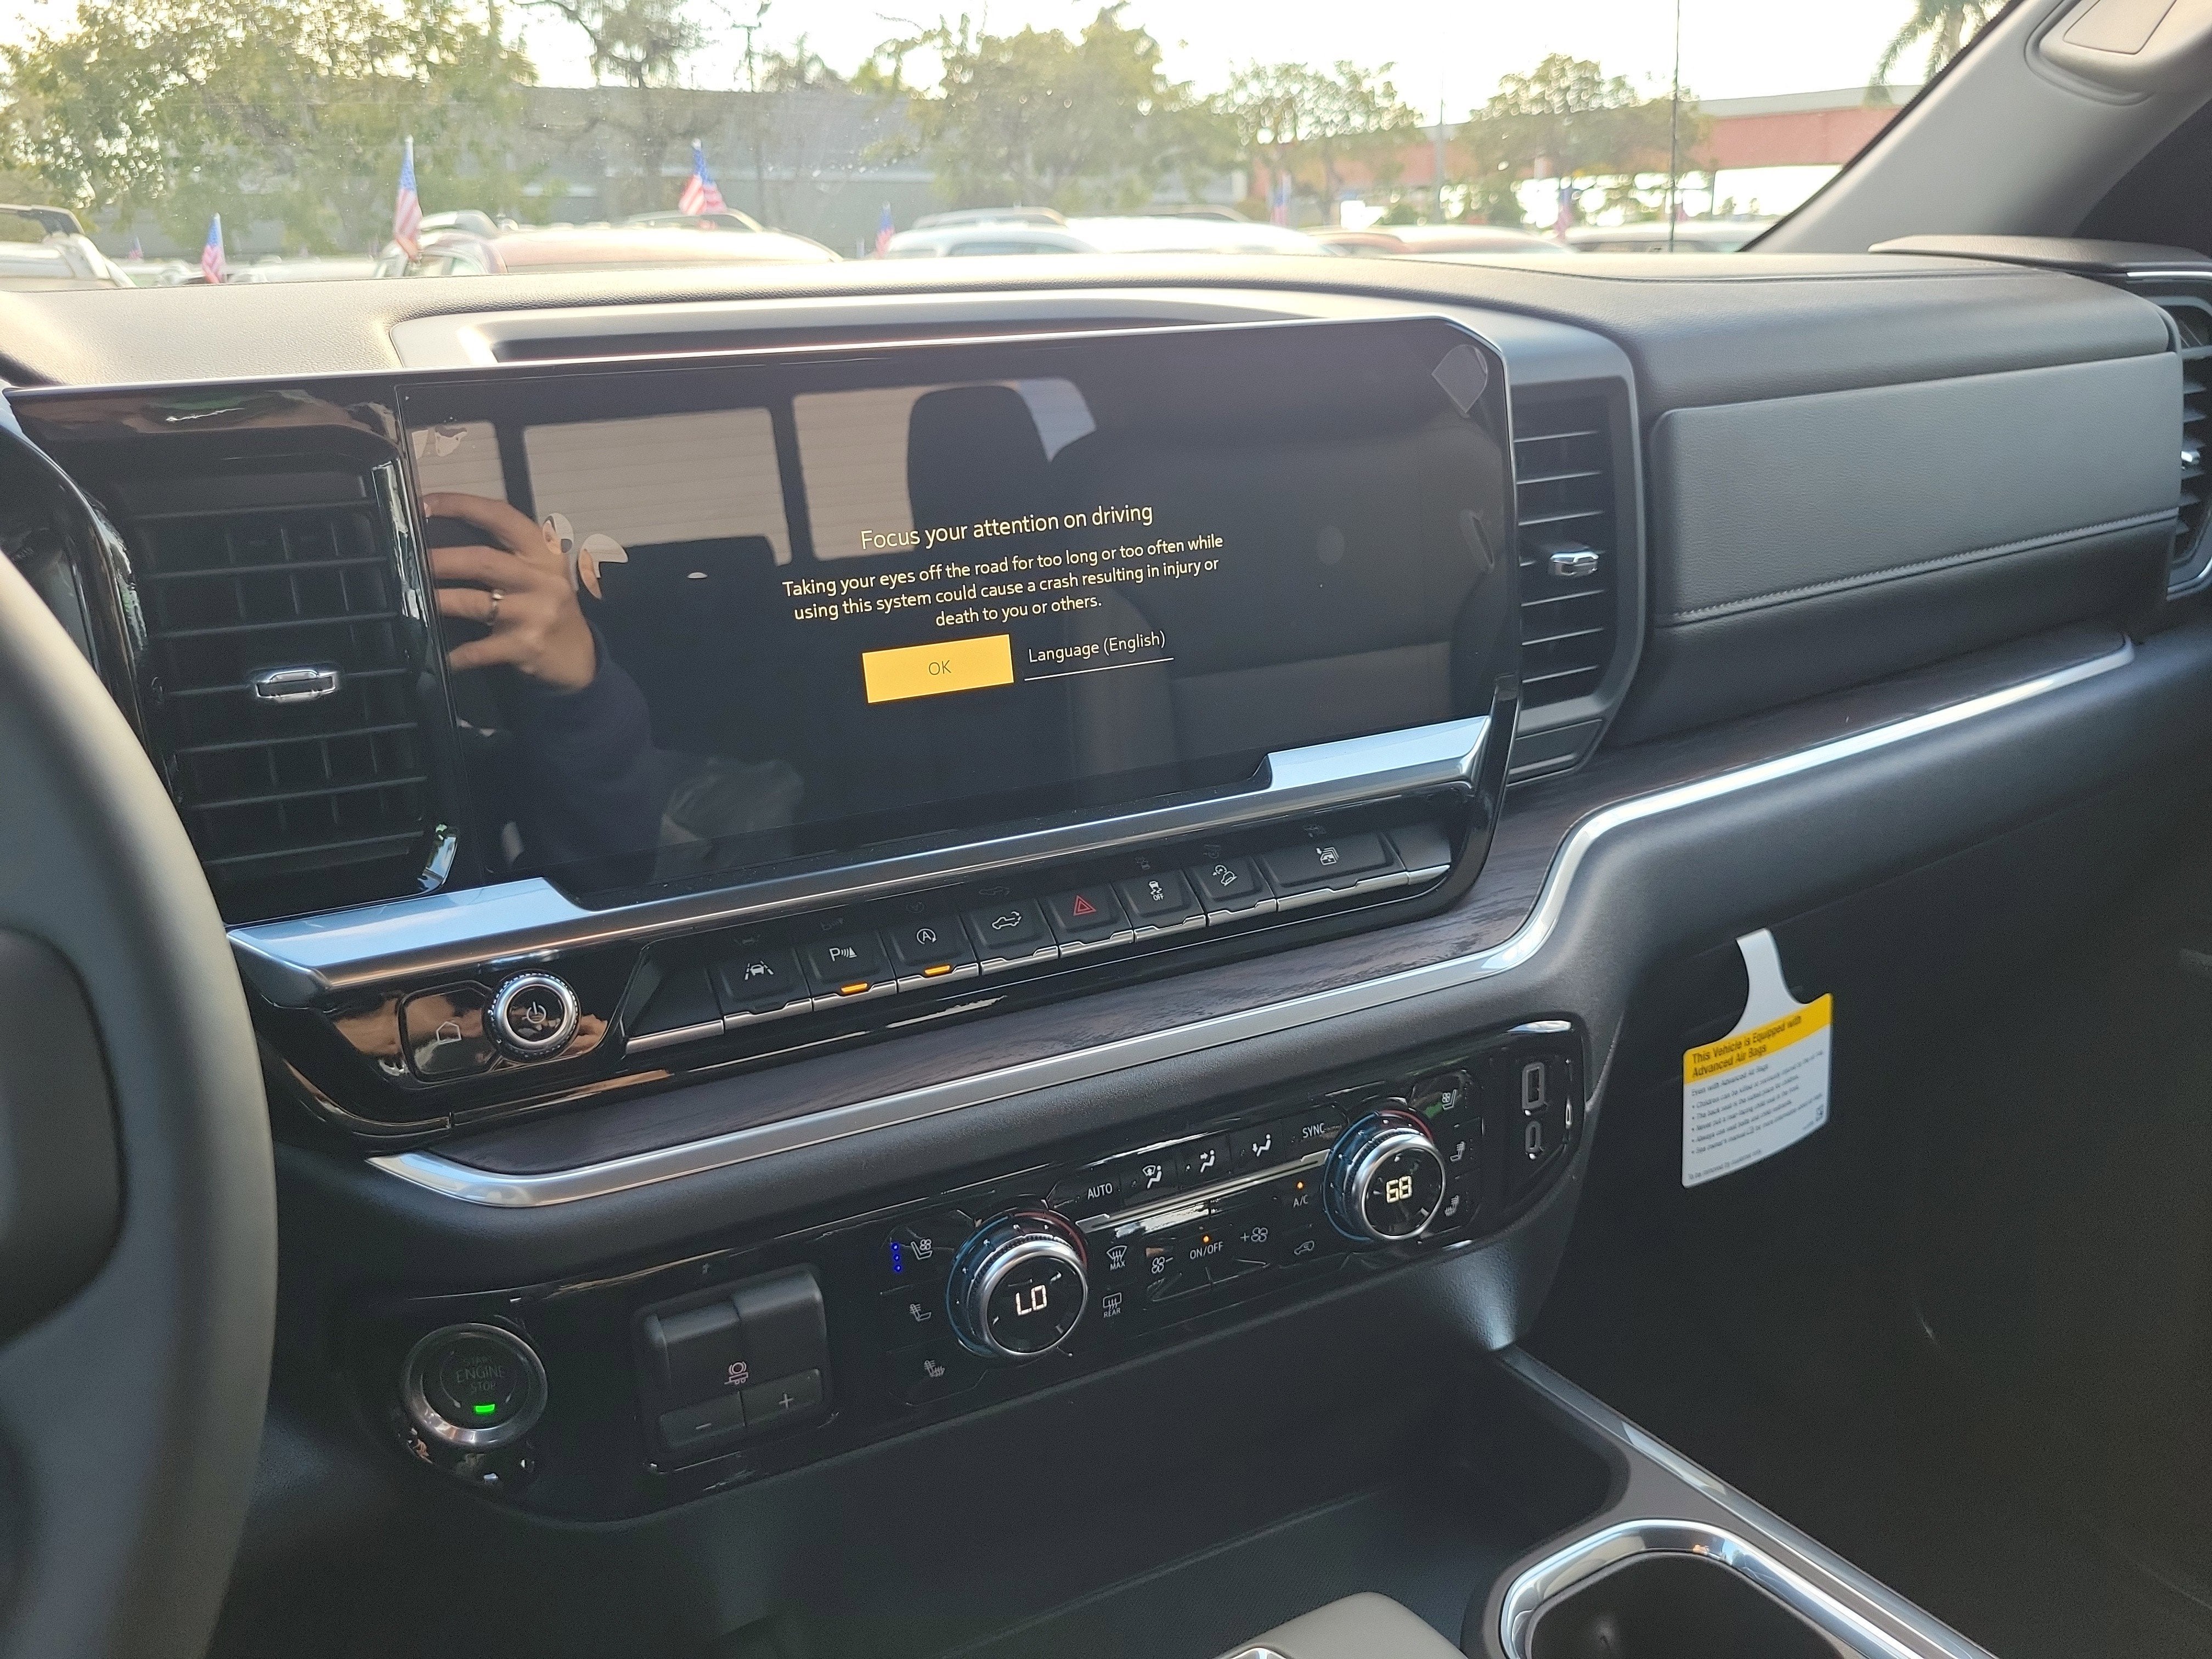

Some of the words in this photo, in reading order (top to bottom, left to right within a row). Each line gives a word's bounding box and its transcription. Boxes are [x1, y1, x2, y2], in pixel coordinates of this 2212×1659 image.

[861, 530, 921, 550] Focus
[924, 526, 968, 549] your
[973, 514, 1059, 538] attention
[1064, 514, 1087, 528] on
[1092, 504, 1153, 526] driving
[782, 579, 837, 597] Taking
[839, 576, 876, 595] your
[879, 572, 916, 590] eyes
[919, 563, 943, 581] off
[945, 562, 970, 578] the
[974, 556, 1008, 575] road
[1012, 555, 1034, 571] for
[1036, 554, 1062, 568] too
[1065, 549, 1098, 566] long
[1101, 549, 1117, 560] or
[1119, 545, 1144, 558] too
[1147, 539, 1184, 555] often
[1187, 533, 1223, 551] while
[794, 603, 839, 620] using
[842, 597, 872, 614] this
[876, 594, 932, 614] system
[935, 583, 977, 603] could
[980, 583, 1024, 597] cause
[1027, 582, 1036, 592] a
[1039, 572, 1079, 590] crash
[1082, 567, 1143, 586] resulting
[1147, 564, 1160, 578] in
[1163, 561, 1201, 579] injury
[1204, 560, 1219, 571] or
[936, 607, 979, 626] death
[982, 607, 998, 620] to
[1001, 605, 1028, 623] you
[1032, 602, 1048, 614] or
[1051, 595, 1102, 612] others.
[1029, 644, 1099, 663] Language
[1104, 630, 1165, 656] (English)
[928, 659, 952, 675] OK
[1692, 1052, 1711, 1064] This
[1713, 1040, 1742, 1058] Vehicle
[1743, 1036, 1751, 1047] is
[1752, 1022, 1786, 1043] Equipped
[1692, 1055, 1734, 1077] Advanced
[1748, 1044, 1766, 1058] Bags
[1302, 1122, 1325, 1139] SYNC
[1087, 1182, 1113, 1200] AUTO
[1293, 1194, 1308, 1208] A/C
[1386, 1175, 1412, 1204] 68
[1110, 1260, 1126, 1271] MAX
[1189, 1241, 1224, 1260] ON/OFF
[1015, 1284, 1047, 1316] LO
[1103, 1307, 1121, 1318] REAR
